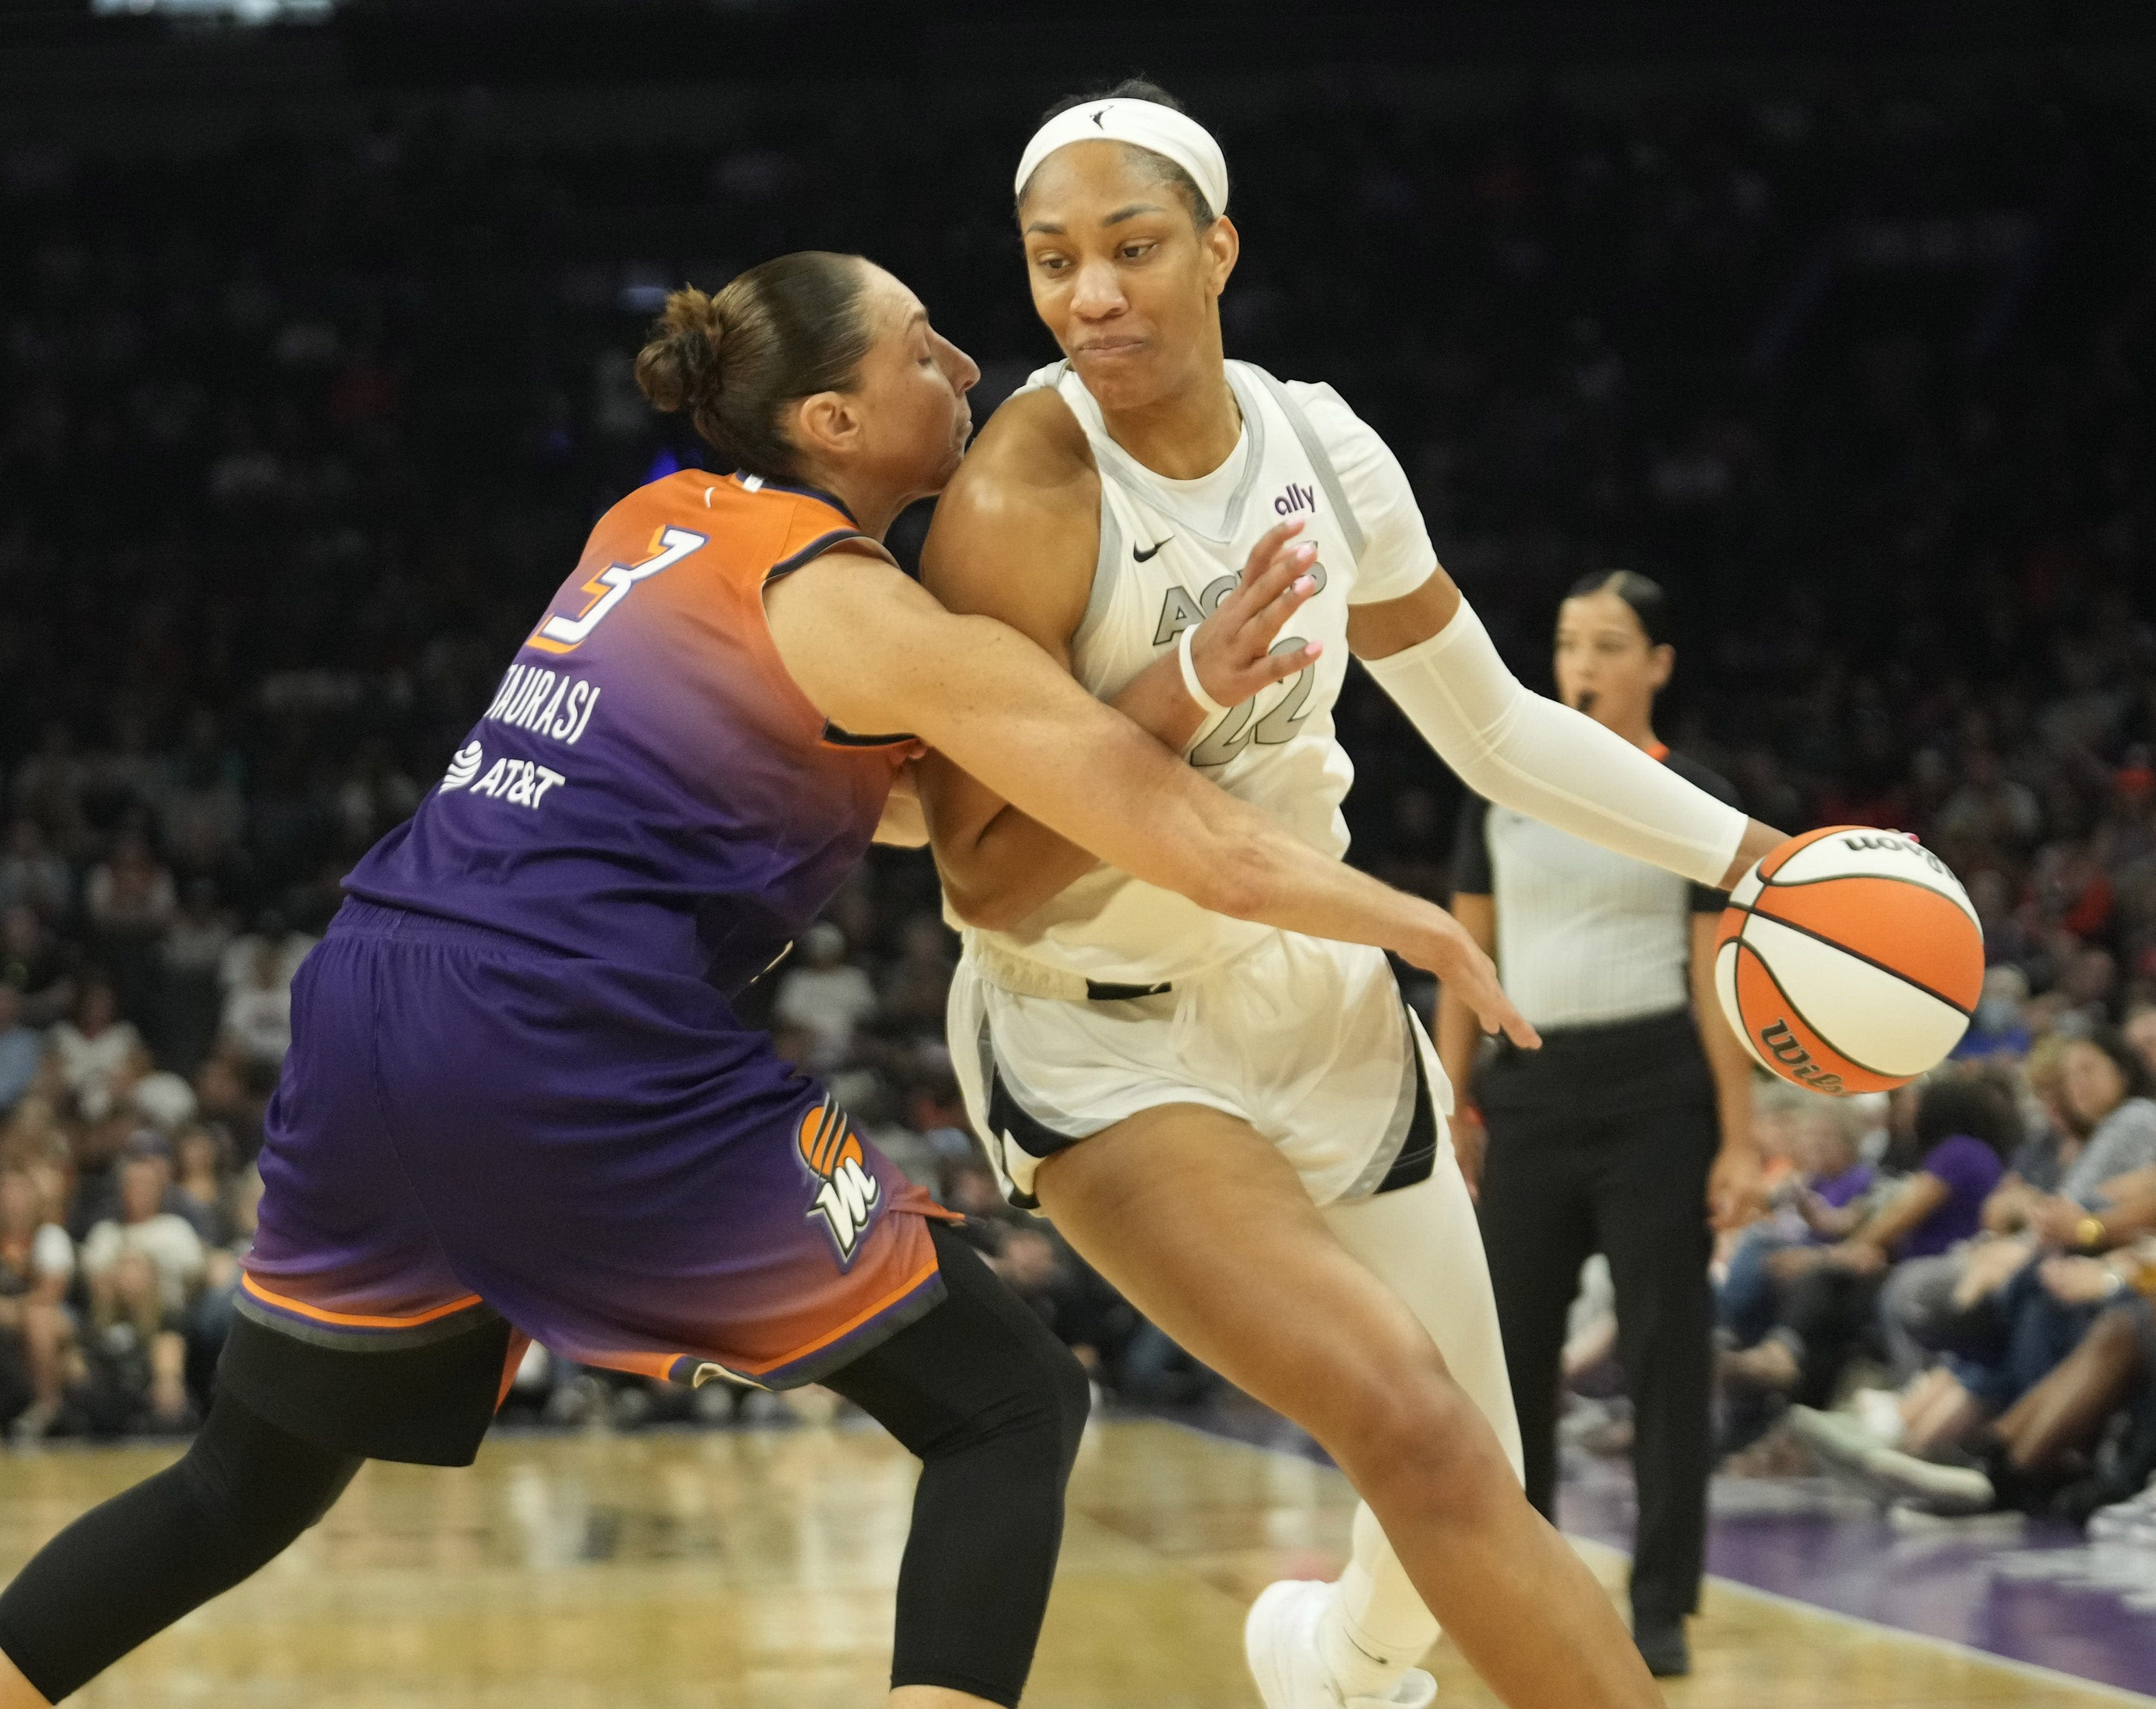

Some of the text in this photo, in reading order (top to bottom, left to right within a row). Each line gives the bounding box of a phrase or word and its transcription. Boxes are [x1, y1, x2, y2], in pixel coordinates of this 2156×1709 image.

[1274, 483, 1316, 516] ally
[526, 524, 710, 654] 3
[1152, 540, 1327, 646] AC
[1189, 635, 1317, 767] 22
[469, 757, 566, 810] AT&T
[1760, 1017, 1847, 1095] Wils
